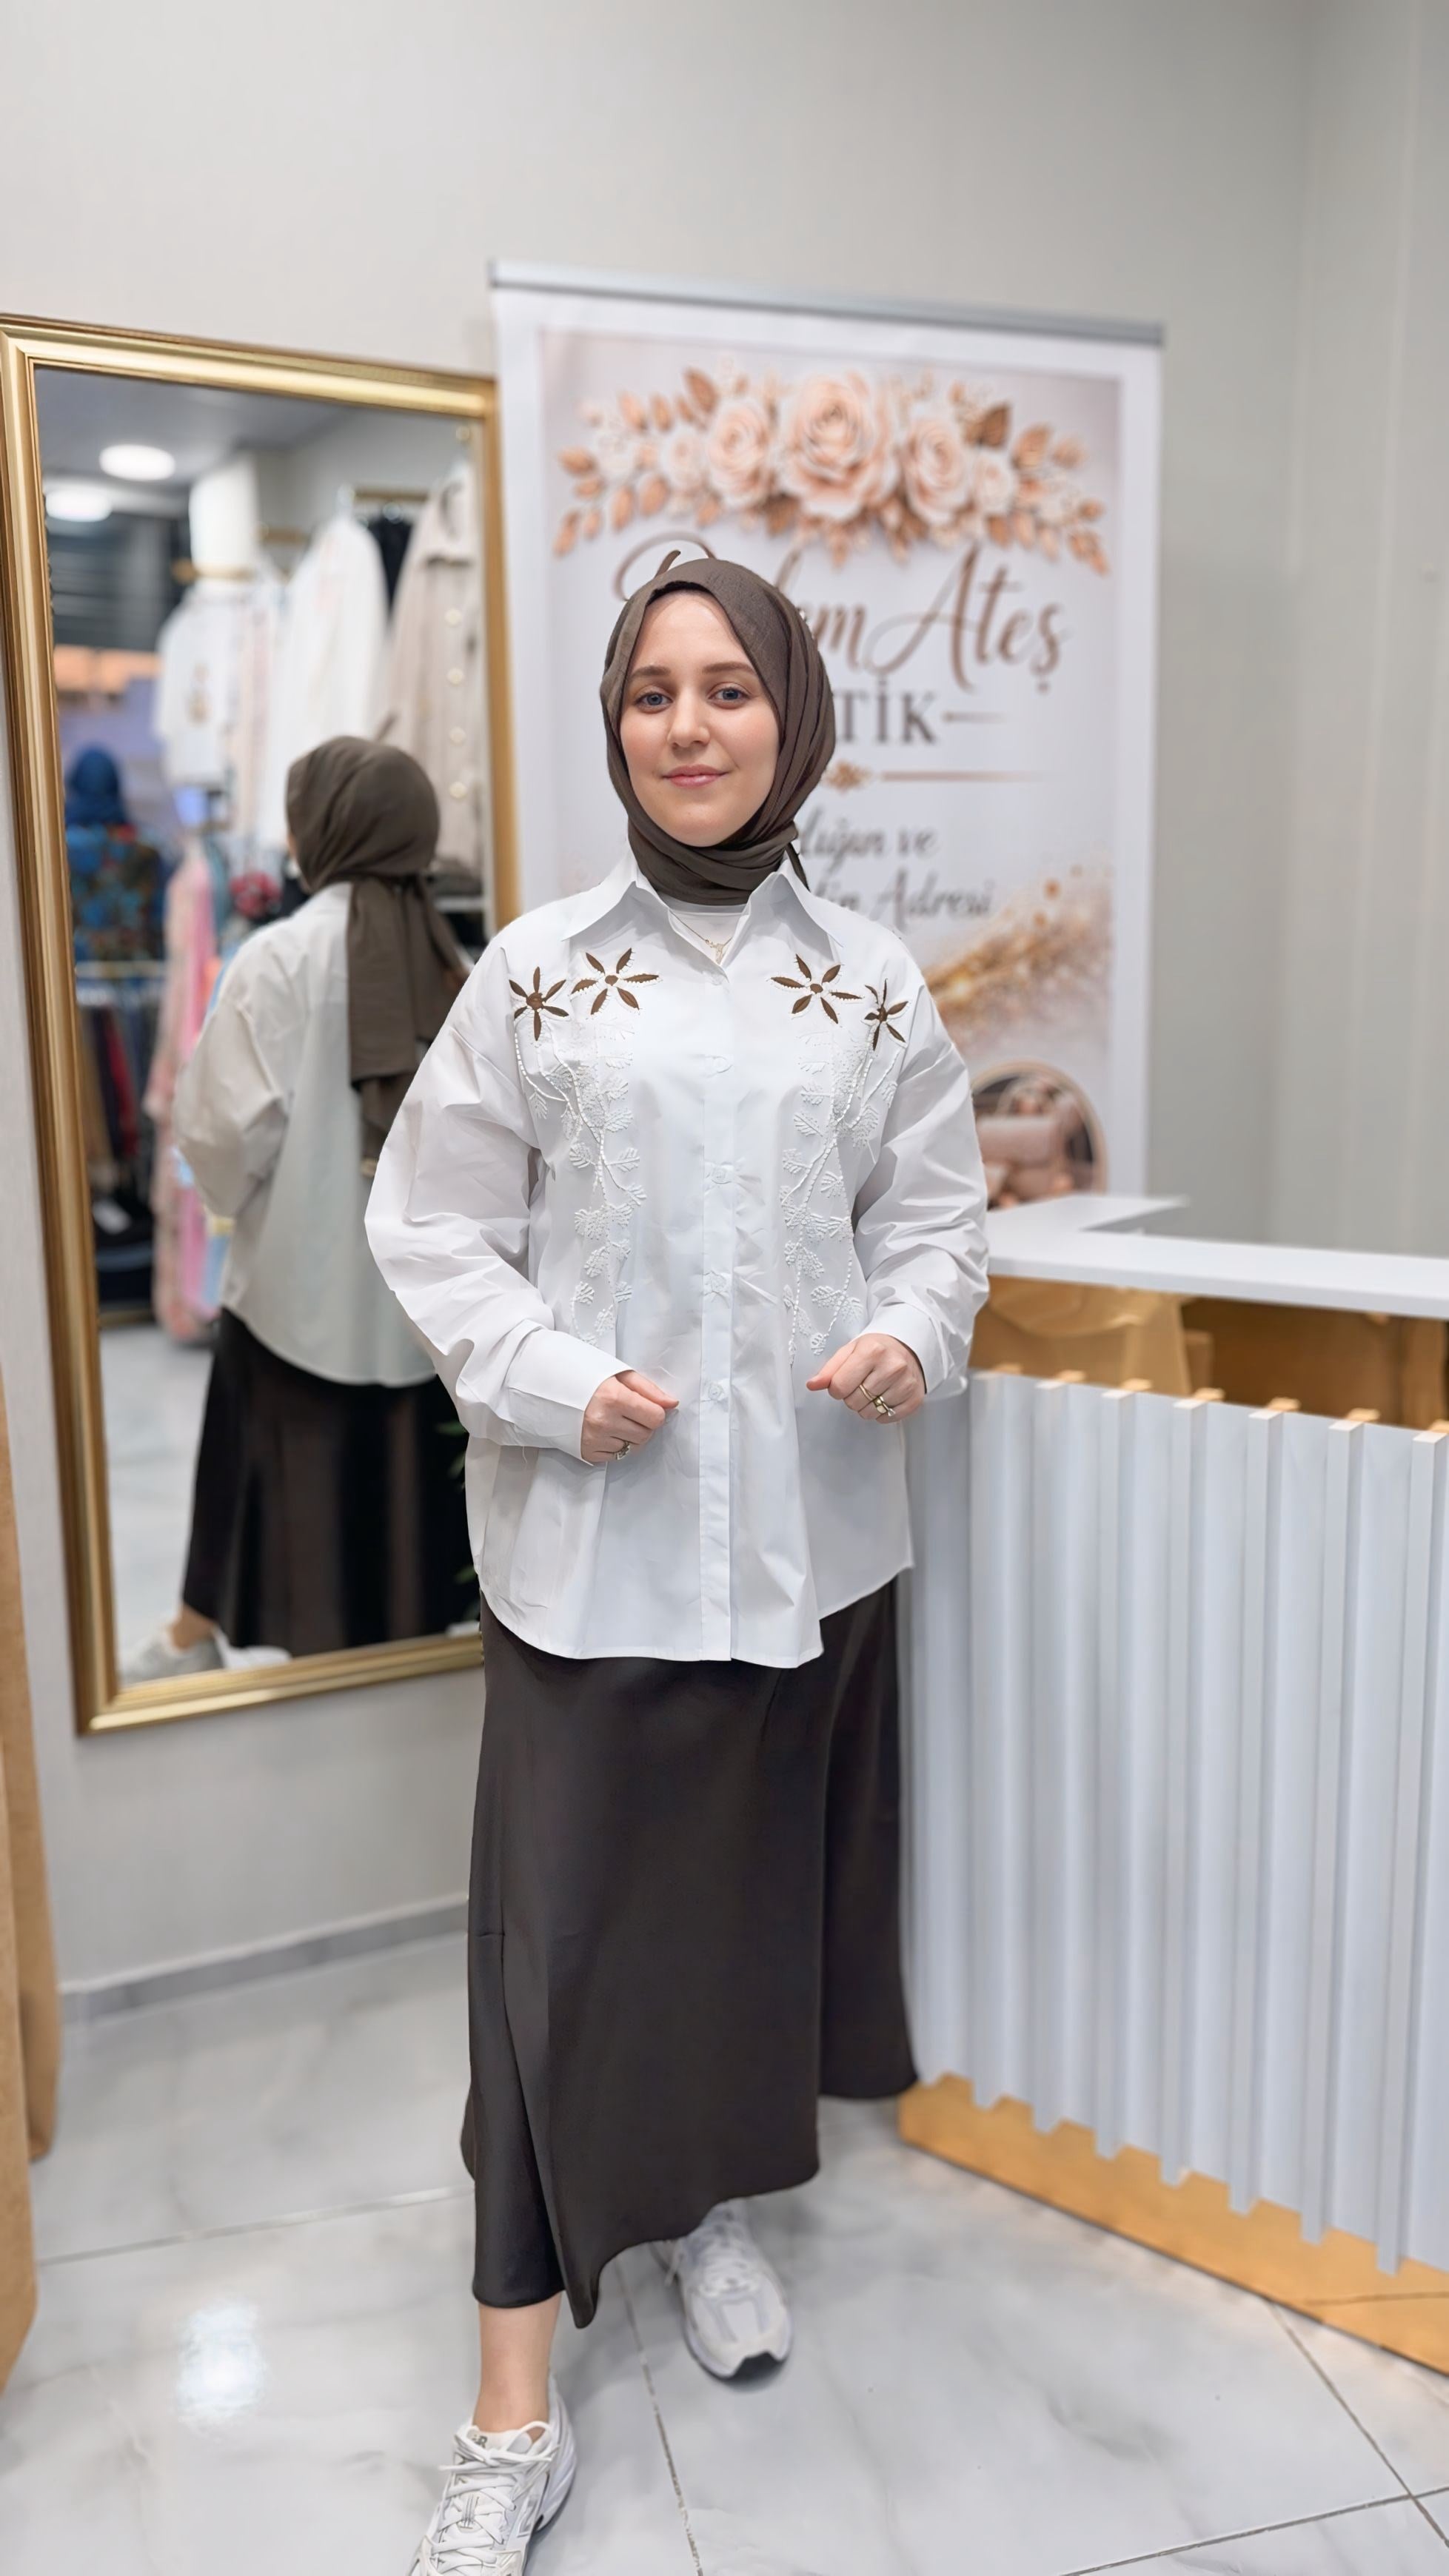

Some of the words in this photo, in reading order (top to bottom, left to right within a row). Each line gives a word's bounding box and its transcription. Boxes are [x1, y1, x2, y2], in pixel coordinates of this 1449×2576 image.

[861, 541, 1072, 694] Ateş
[834, 677, 939, 744] TİK
[897, 828, 937, 856] ve
